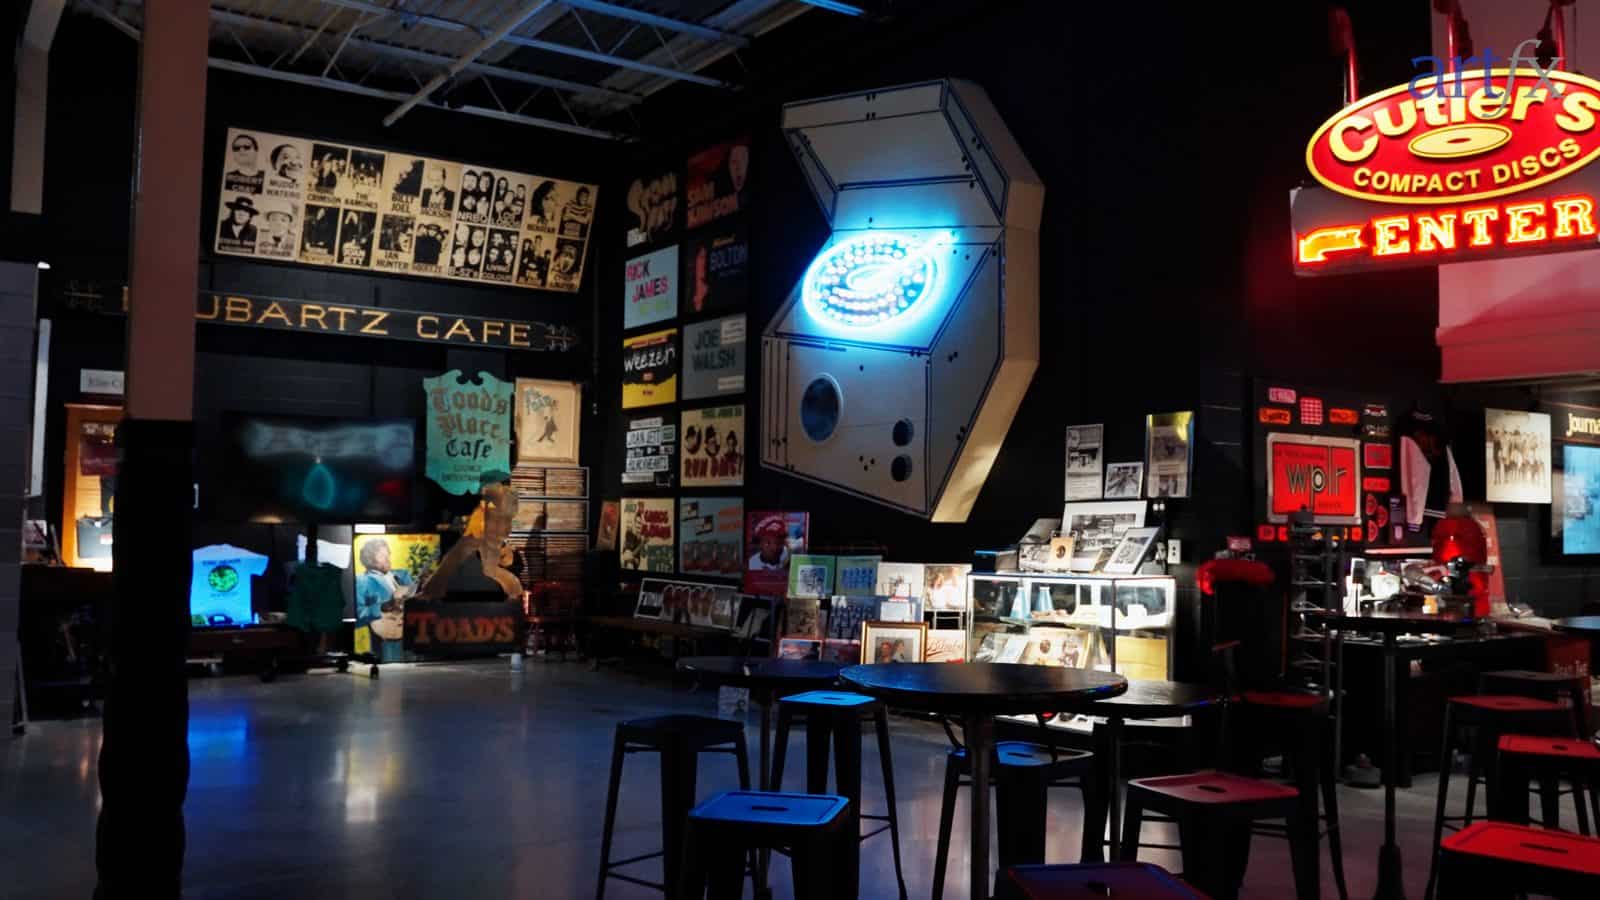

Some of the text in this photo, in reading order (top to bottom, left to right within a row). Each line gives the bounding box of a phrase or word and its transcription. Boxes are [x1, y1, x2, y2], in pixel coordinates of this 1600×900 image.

[1353, 138, 1584, 193] COMPACT DISCS
[1374, 198, 1598, 257] ENTER
[626, 259, 651, 281] RICK
[631, 274, 669, 303] JAMES
[416, 315, 532, 348] CAFE
[694, 328, 721, 351] JOE
[691, 346, 737, 372] WALSH
[445, 438, 493, 460] Cafe
[1286, 462, 1348, 504] wplr
[406, 609, 516, 645] TOAD'S
